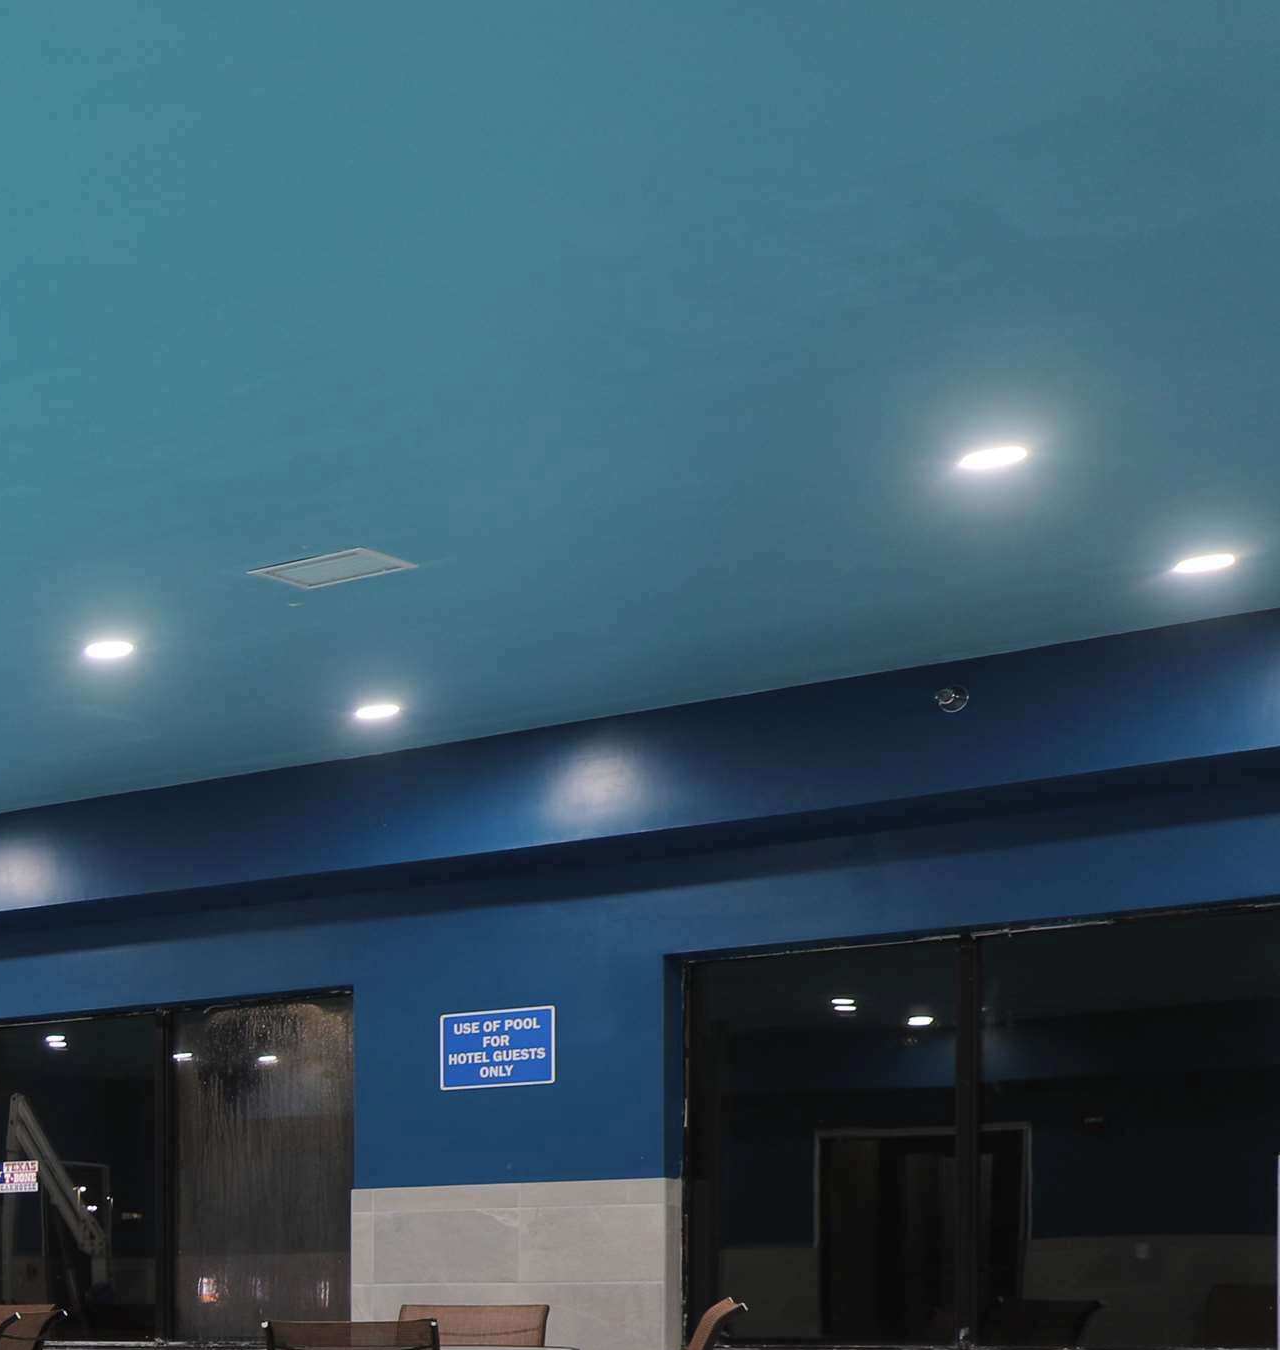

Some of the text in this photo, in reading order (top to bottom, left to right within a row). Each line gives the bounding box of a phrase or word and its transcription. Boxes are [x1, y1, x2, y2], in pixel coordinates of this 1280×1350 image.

[453, 1017, 541, 1035] USE OF POOL
[482, 1034, 510, 1048] FOR
[448, 1047, 546, 1066] HOTEL GUESTS
[479, 1064, 514, 1078] ONLY
[4, 1162, 37, 1172] TEXAS
